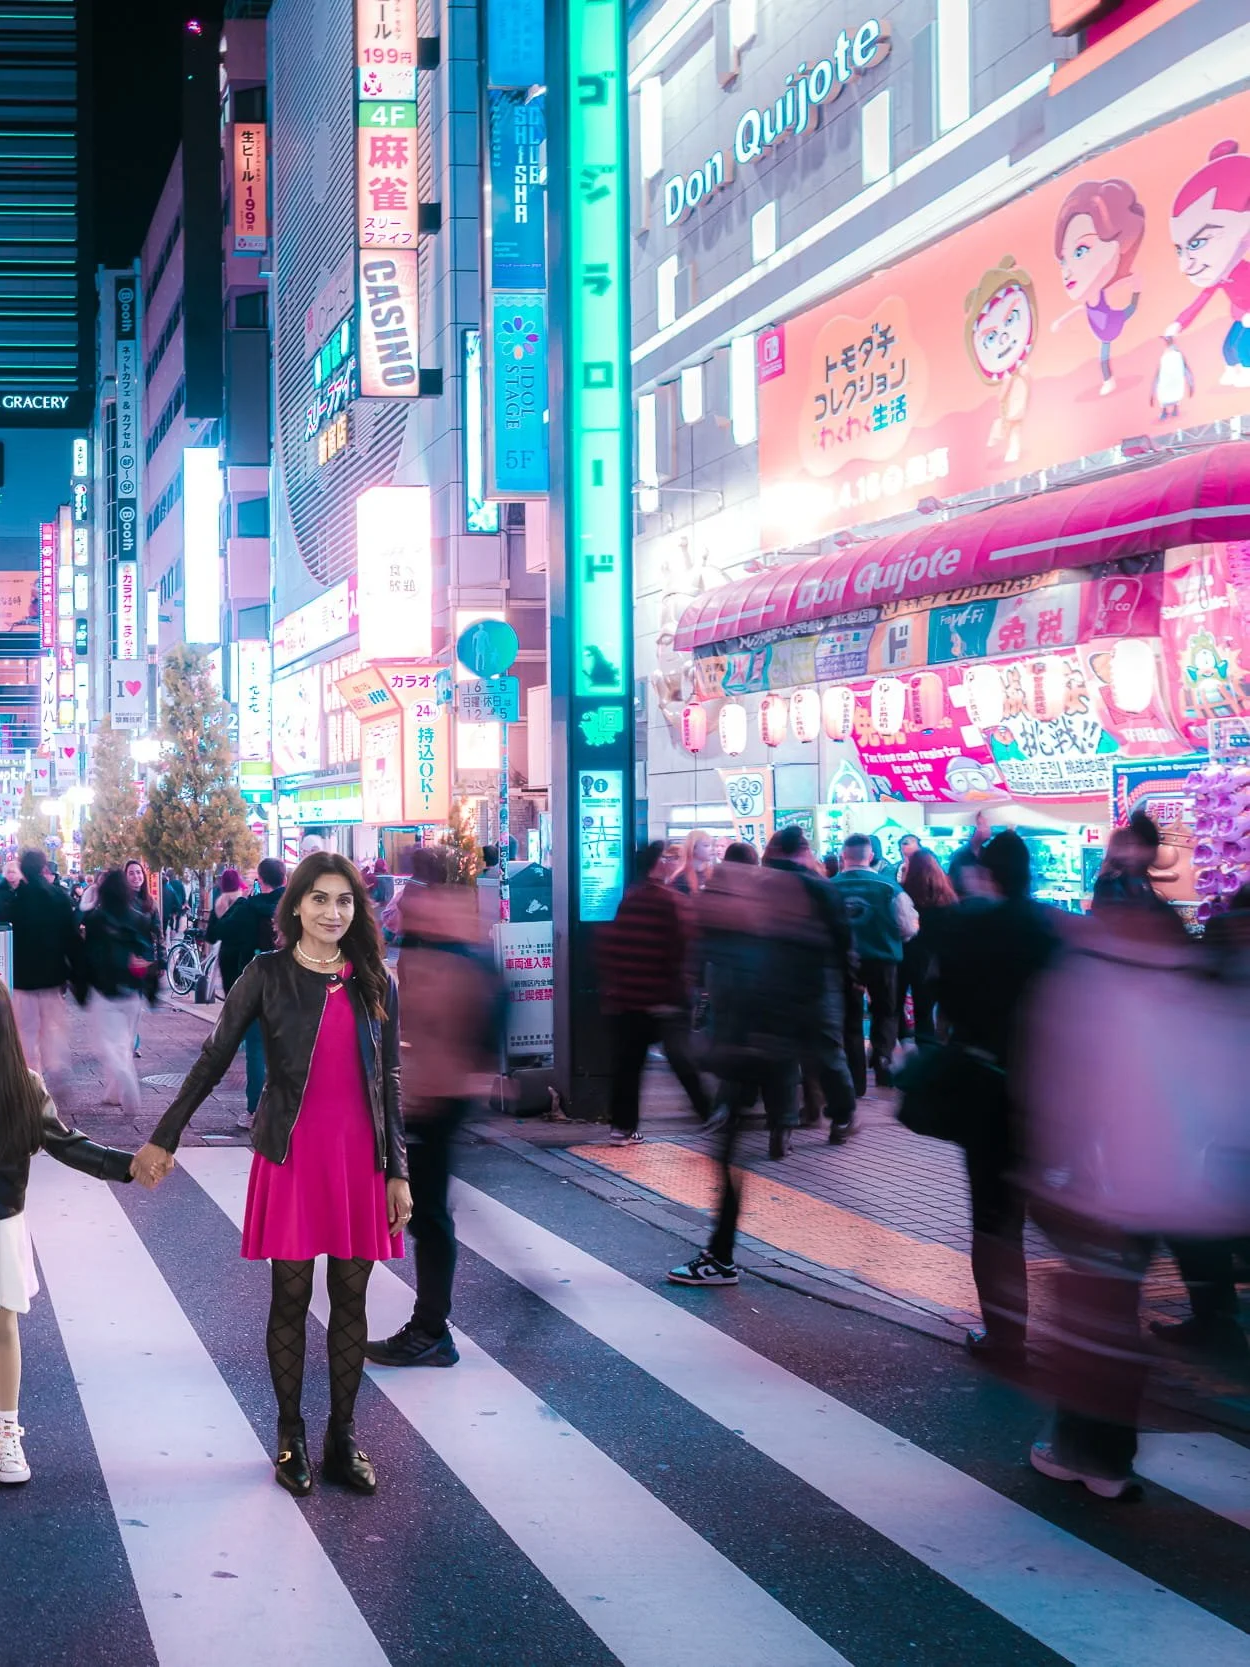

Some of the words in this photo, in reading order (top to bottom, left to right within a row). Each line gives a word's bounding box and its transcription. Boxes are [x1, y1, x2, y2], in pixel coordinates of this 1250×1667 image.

[363, 47, 412, 64] 199円
[370, 105, 406, 126] 4F
[664, 150, 725, 228] Don
[734, 18, 882, 165] Quijote
[241, 130, 255, 182] 生ビール
[368, 134, 410, 212] 麻雀
[364, 216, 402, 230] スリー
[118, 287, 135, 333] Booth
[362, 259, 417, 388] CASINO
[825, 322, 896, 384] トモダチ
[2, 395, 70, 410] GRACERY
[505, 364, 521, 430] STAGE
[521, 365, 536, 419] IDOL
[815, 357, 907, 422] コレクション
[505, 450, 535, 470] 5F
[119, 506, 136, 552] Booth
[796, 576, 846, 610] Don
[854, 547, 961, 595] Quijote
[998, 606, 1064, 651] 免税
[418, 727, 434, 810] 持込OK!
[901, 775, 934, 792] 3rd
[505, 956, 553, 970] 車両進入禁
